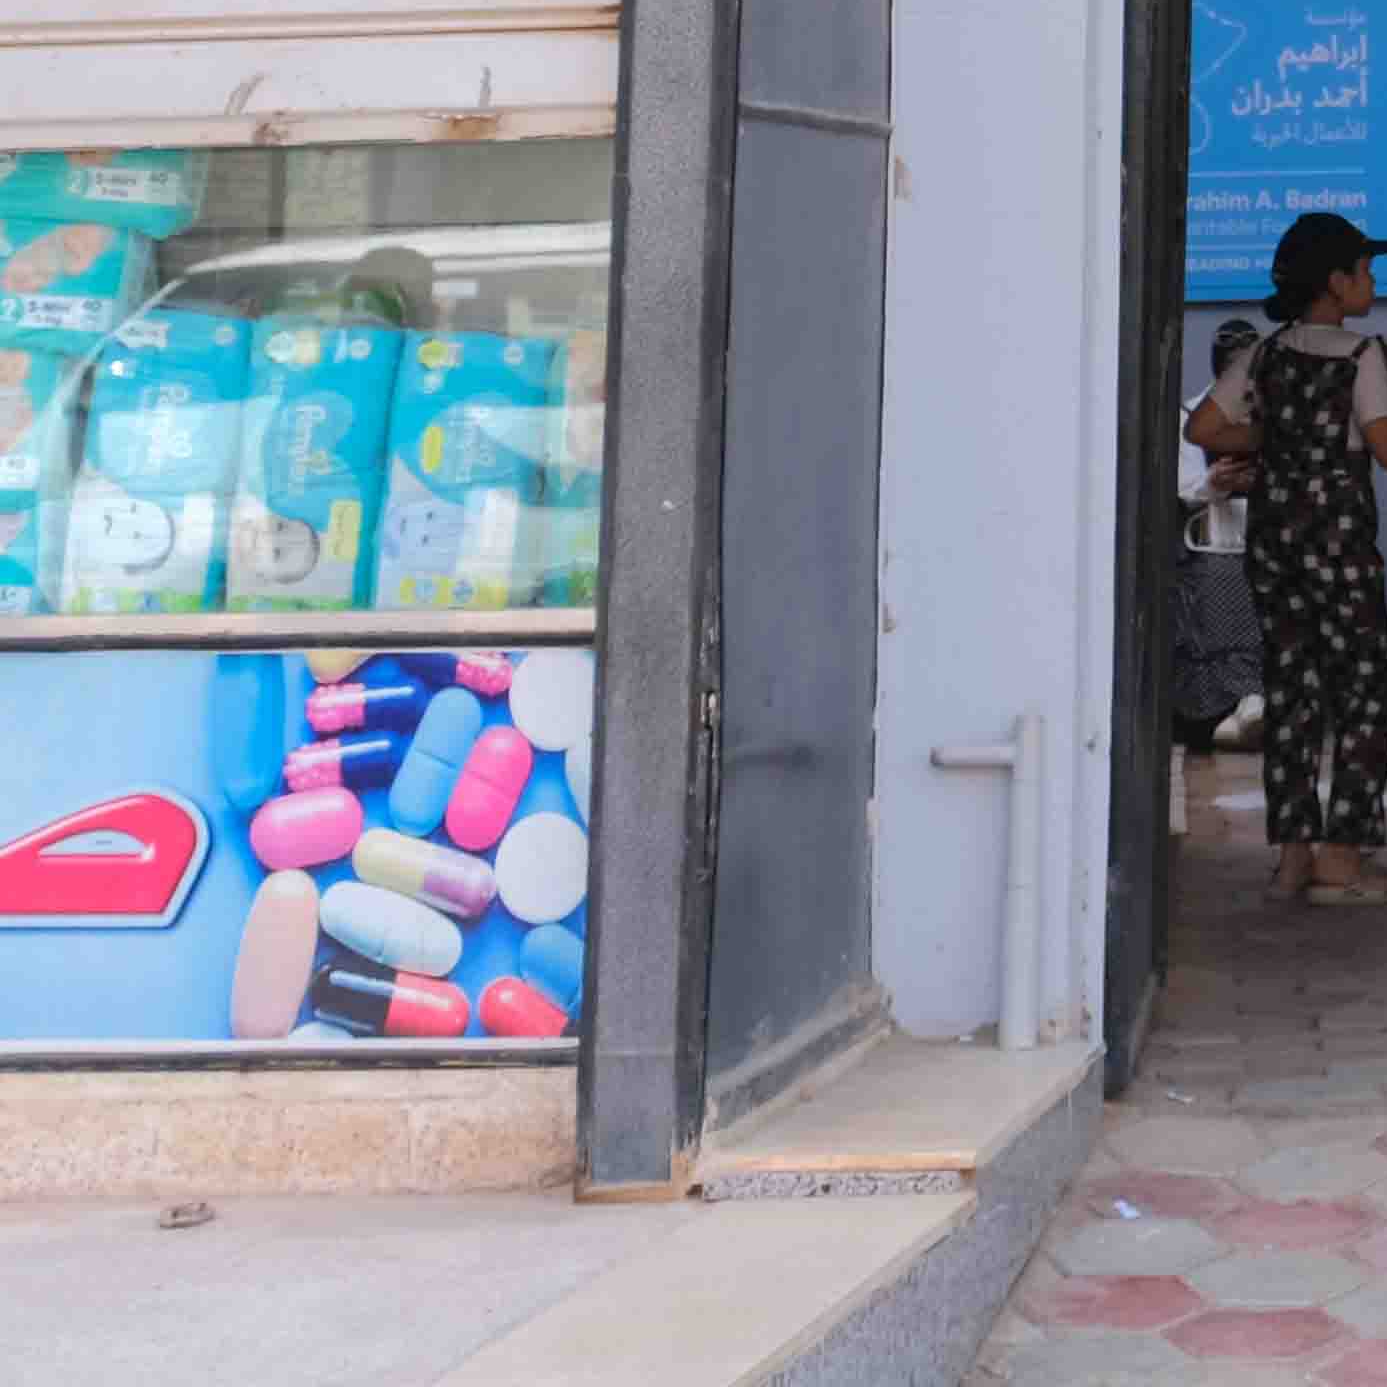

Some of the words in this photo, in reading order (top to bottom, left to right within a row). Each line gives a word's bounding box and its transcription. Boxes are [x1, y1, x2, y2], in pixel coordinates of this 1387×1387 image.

[1230, 75, 1304, 116] بدران
[1256, 189, 1281, 211] A.
[1285, 187, 1368, 211] Badran
